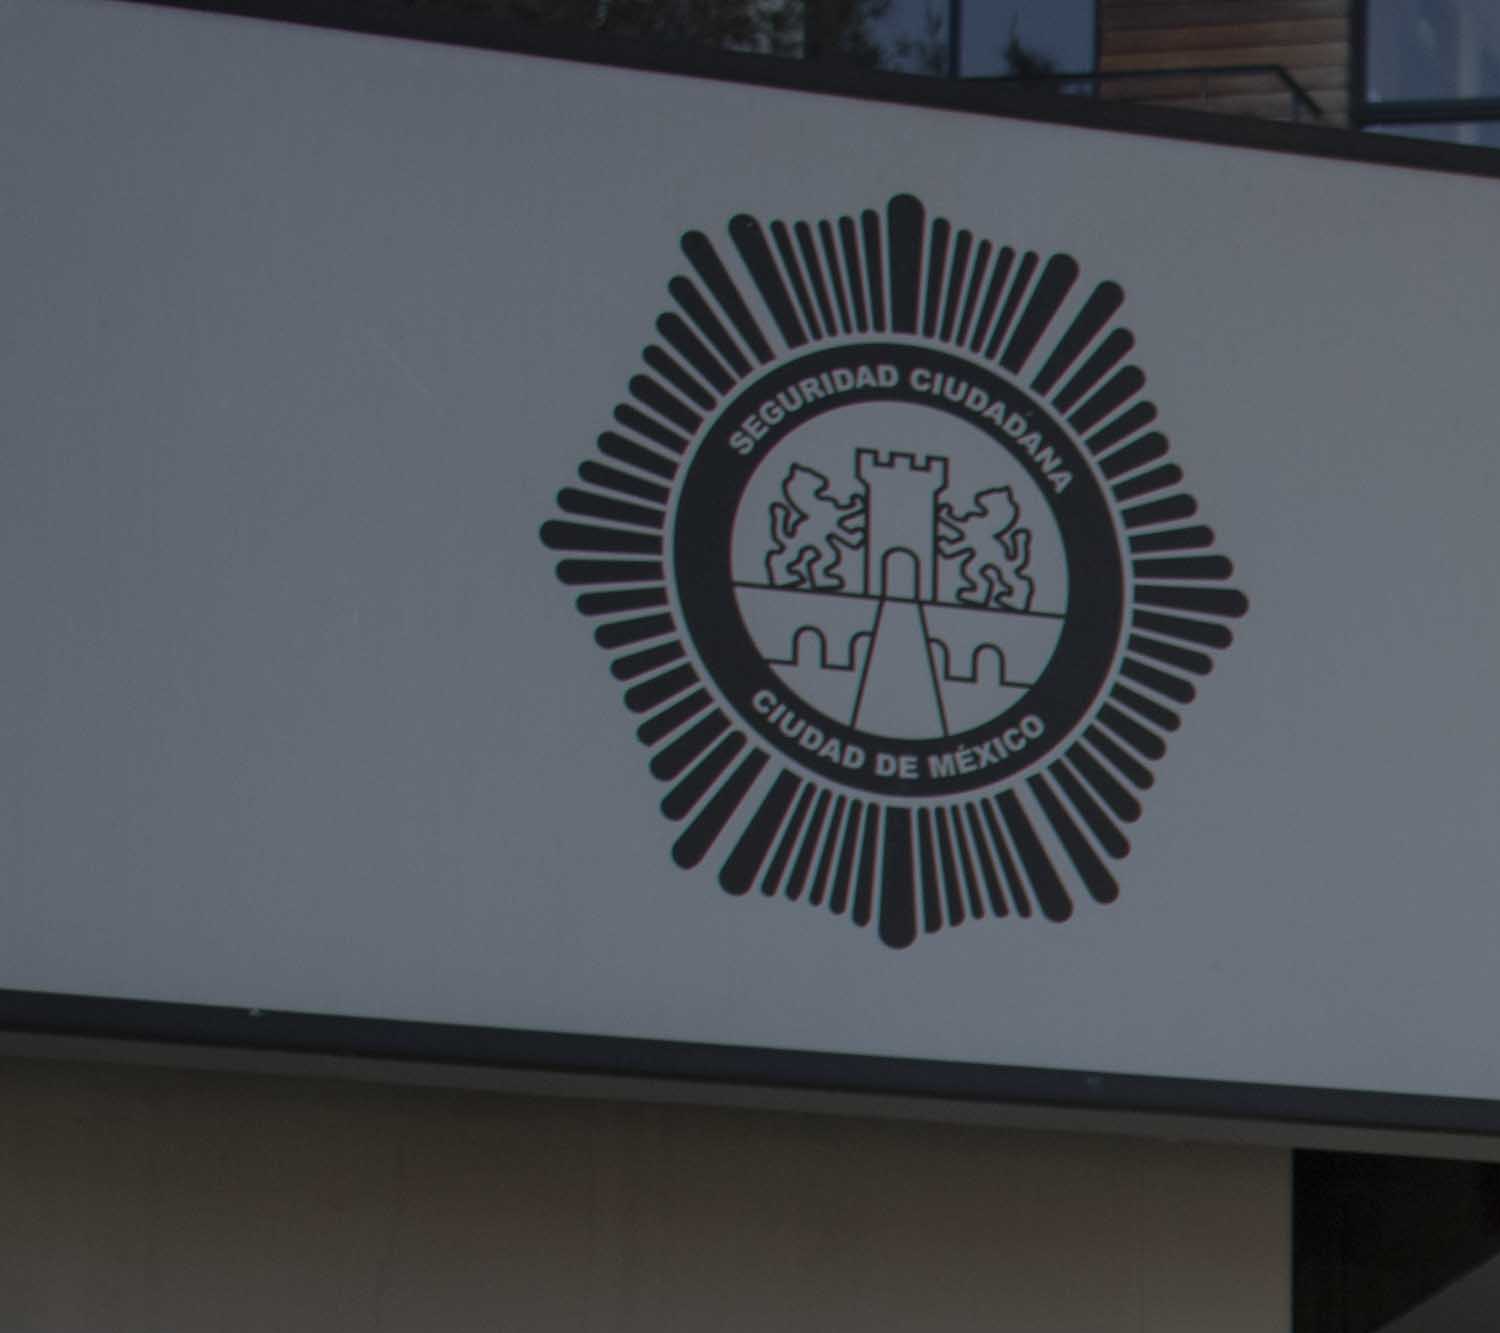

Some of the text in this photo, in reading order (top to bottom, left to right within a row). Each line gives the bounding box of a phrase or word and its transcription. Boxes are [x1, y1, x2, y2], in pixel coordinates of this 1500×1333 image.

[729, 363, 1075, 495] SEGURIDAD CIUDADANA
[751, 688, 1048, 780] CIUDAD DE MÉXICO
